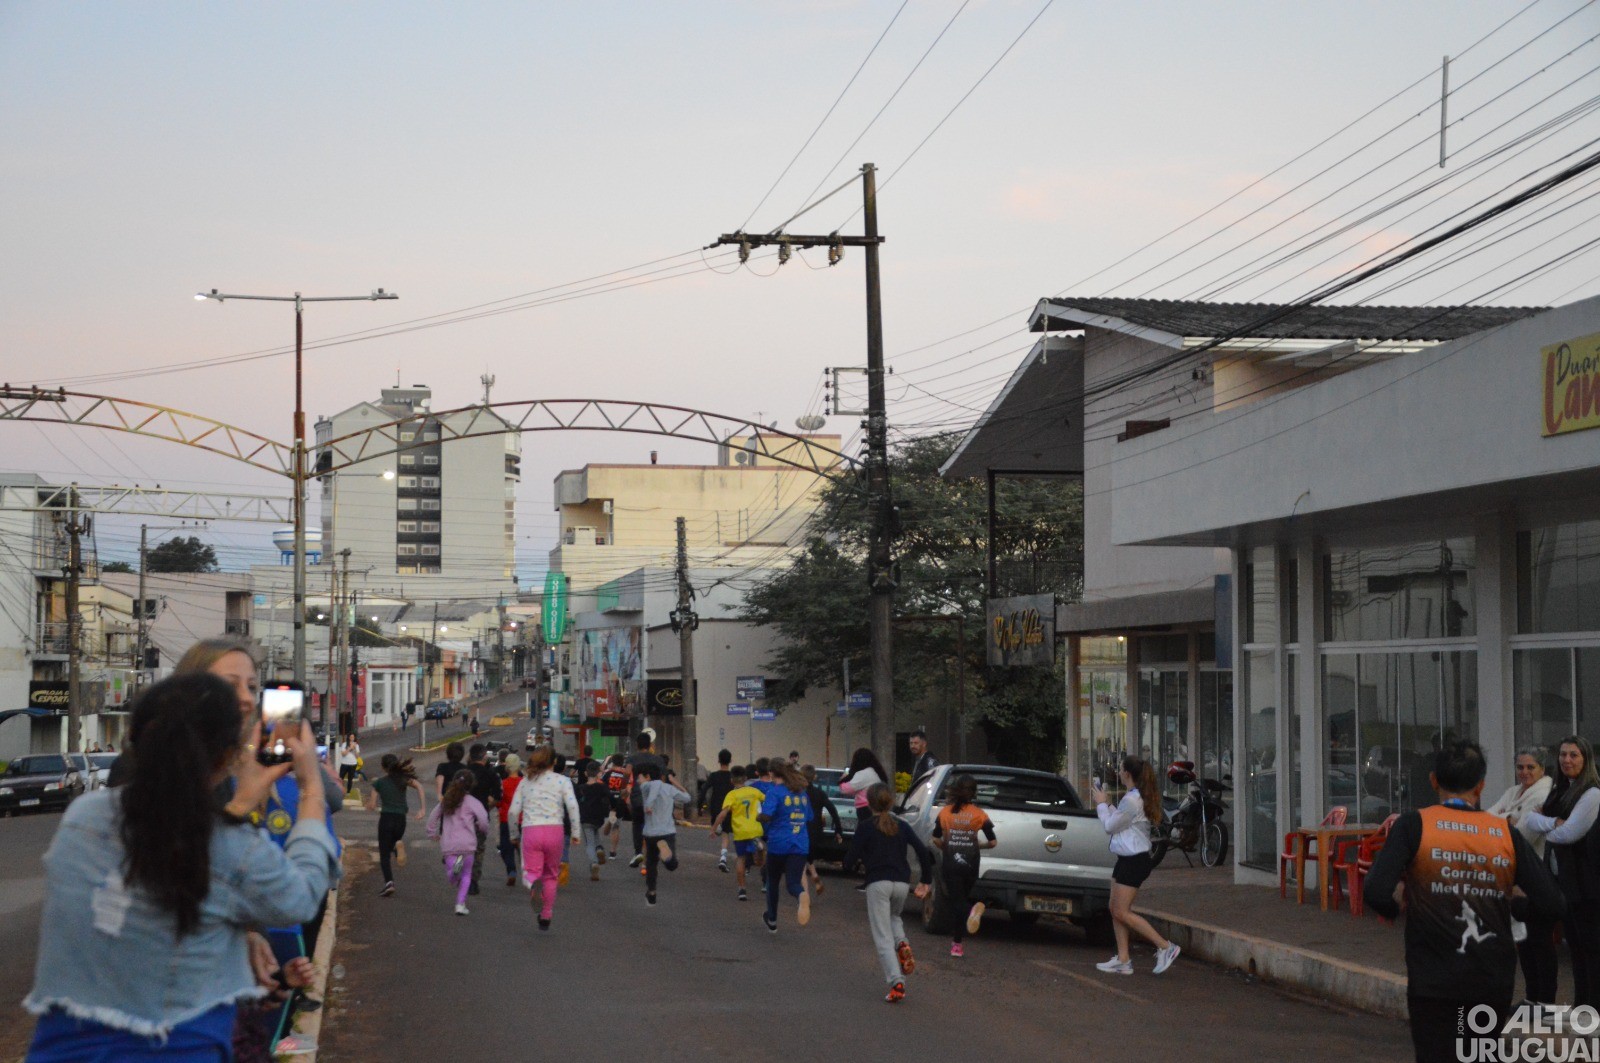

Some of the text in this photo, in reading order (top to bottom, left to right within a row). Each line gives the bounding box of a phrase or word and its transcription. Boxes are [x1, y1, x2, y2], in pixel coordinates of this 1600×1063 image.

[1556, 342, 1600, 386] Duar
[742, 800, 751, 819] 7
[1436, 820, 1478, 834] SEBERI
[1488, 827, 1503, 837] RS
[1431, 848, 1510, 867] Equipe de
[1441, 866, 1496, 882] Corrida
[1431, 882, 1505, 899] Med Forma
